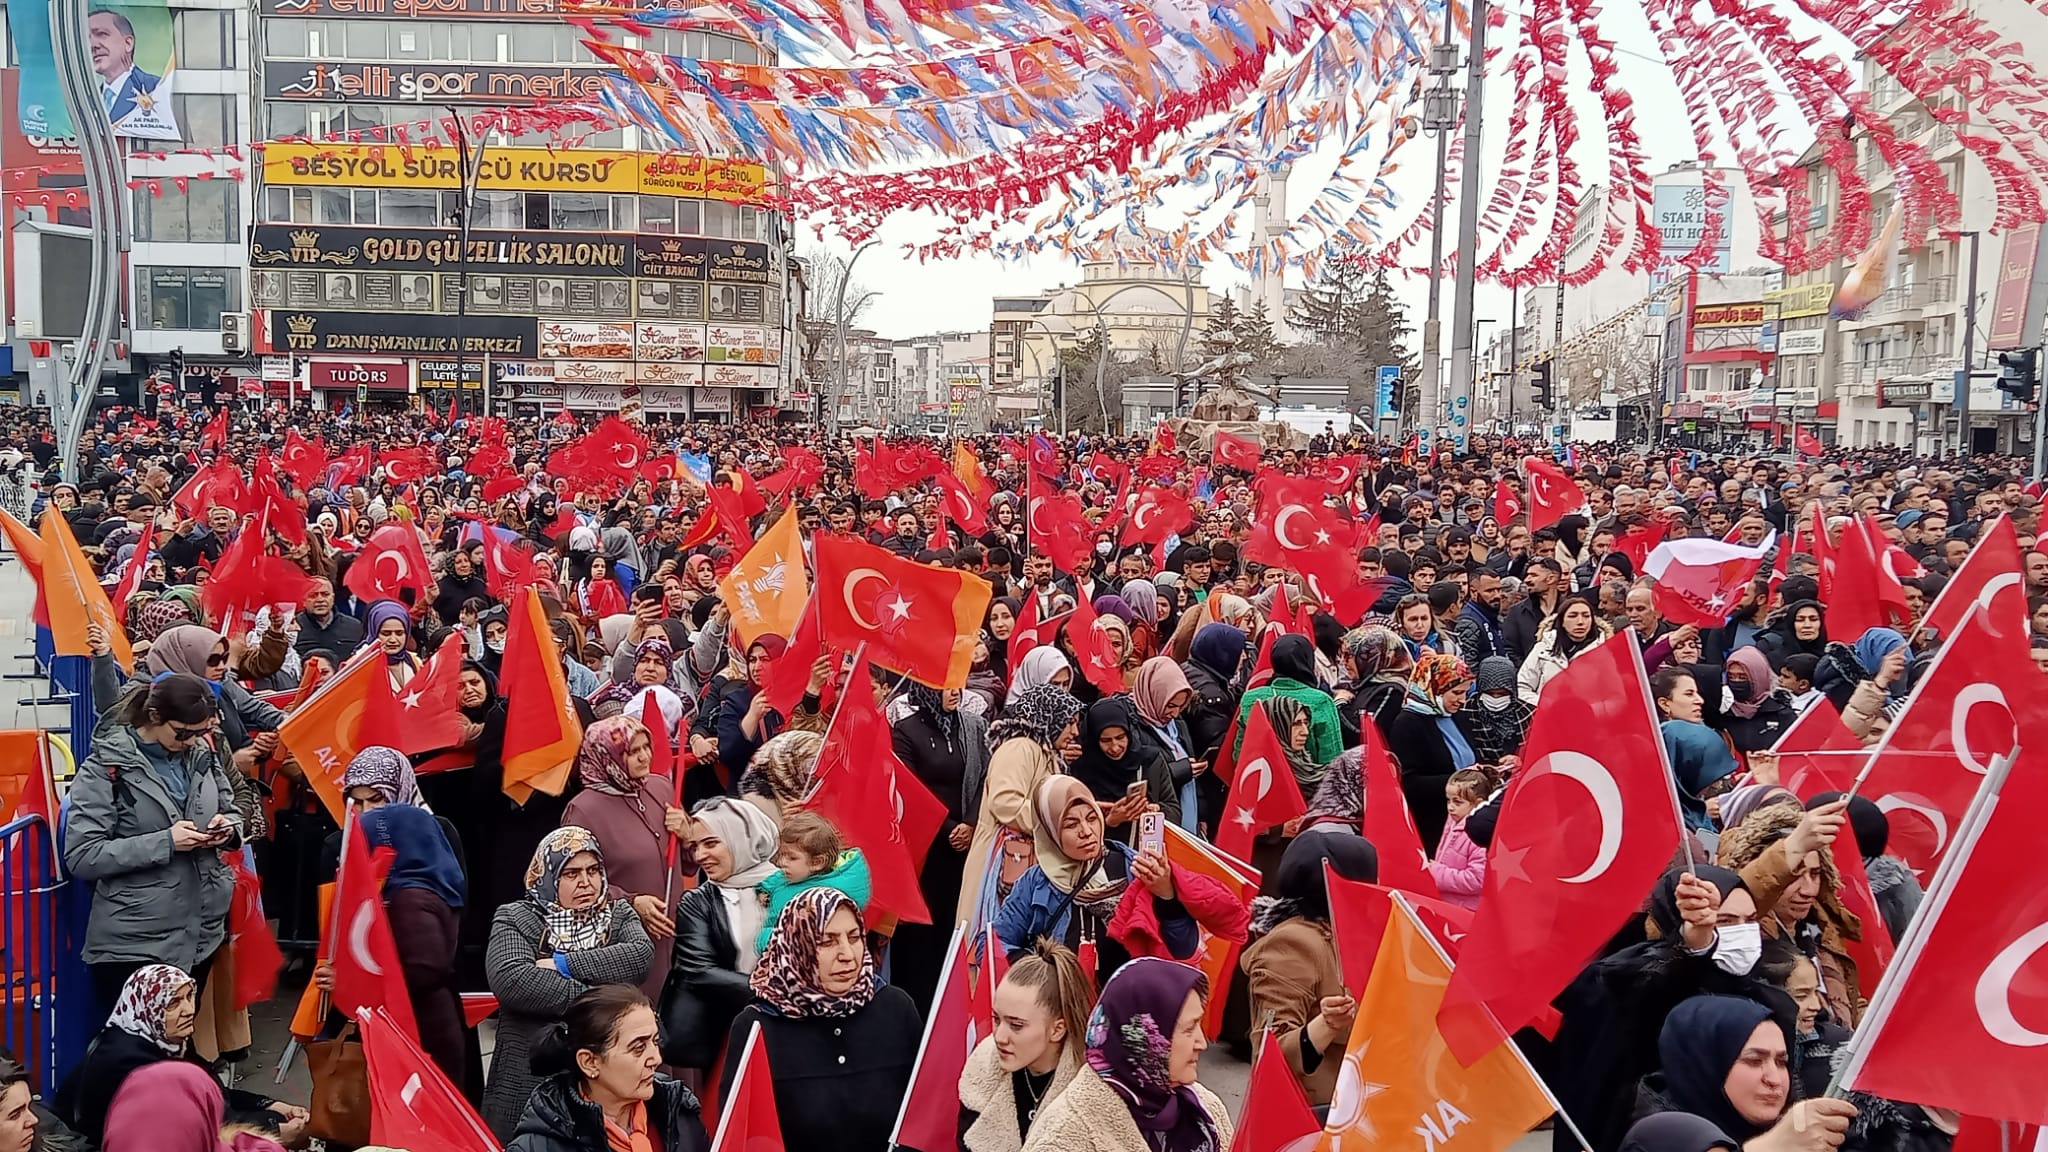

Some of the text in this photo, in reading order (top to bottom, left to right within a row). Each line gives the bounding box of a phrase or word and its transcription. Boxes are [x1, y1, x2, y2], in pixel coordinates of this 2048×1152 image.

[340, 66, 396, 97] elit
[399, 71, 479, 101] spor
[293, 156, 609, 183] BEŞYOL SÜRCÜ KURSU
[643, 178, 675, 187] SÜRÜCÜ
[1662, 212, 1694, 223] STAR
[290, 247, 321, 263] VIP
[363, 238, 422, 264] GOLD
[535, 243, 625, 266] SALONU
[660, 251, 682, 262] VIP
[643, 262, 698, 277] CİLT BAKIMI
[286, 334, 317, 349] VIP
[326, 334, 446, 353] DANIŞMANLIK
[420, 362, 481, 371] CELLEXPESS
[507, 363, 555, 376] bilcom
[330, 369, 387, 383] TUDORS
[432, 370, 470, 382] İLETİŞM
[524, 384, 564, 396] bilcom
[313, 746, 342, 775] AK
